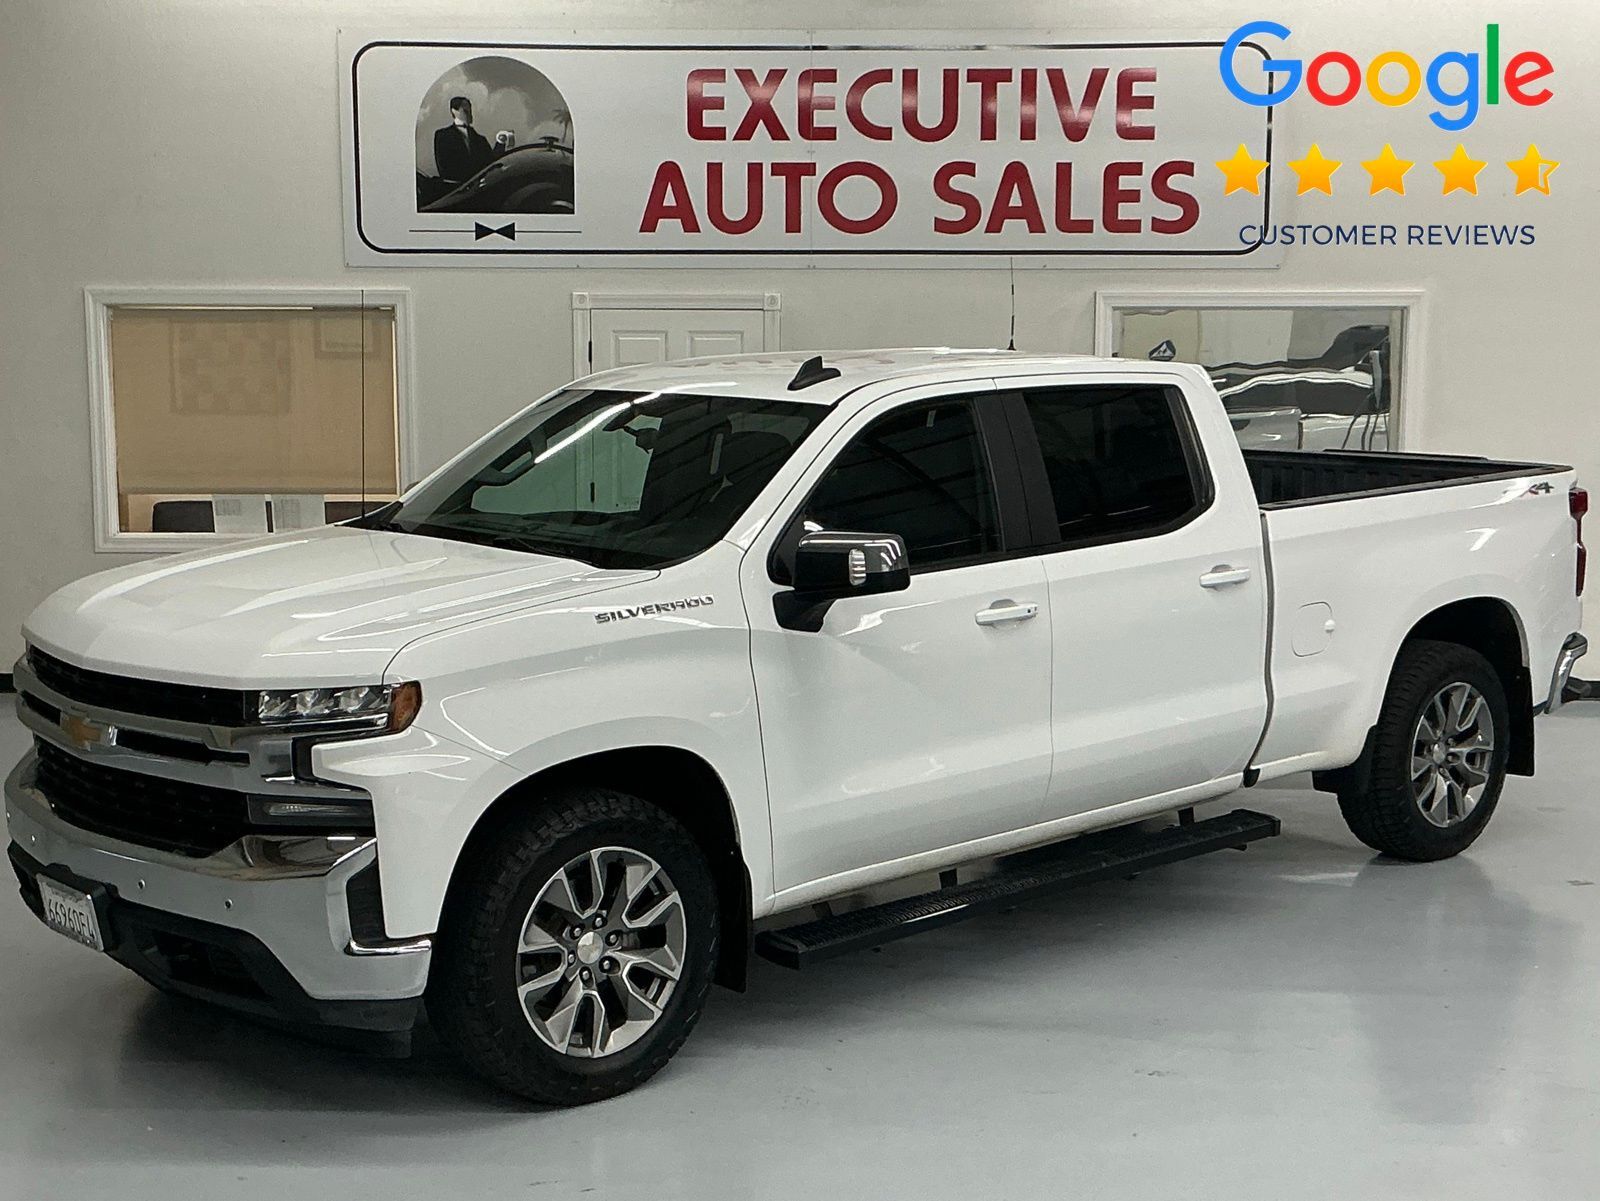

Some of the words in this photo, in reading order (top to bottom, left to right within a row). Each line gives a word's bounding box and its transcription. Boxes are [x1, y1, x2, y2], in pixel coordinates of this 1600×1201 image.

[686, 67, 1156, 143] EXECUTIVE
[639, 160, 897, 236] AUTO
[933, 160, 1200, 236] SALES
[595, 595, 714, 624] SILVERADO
